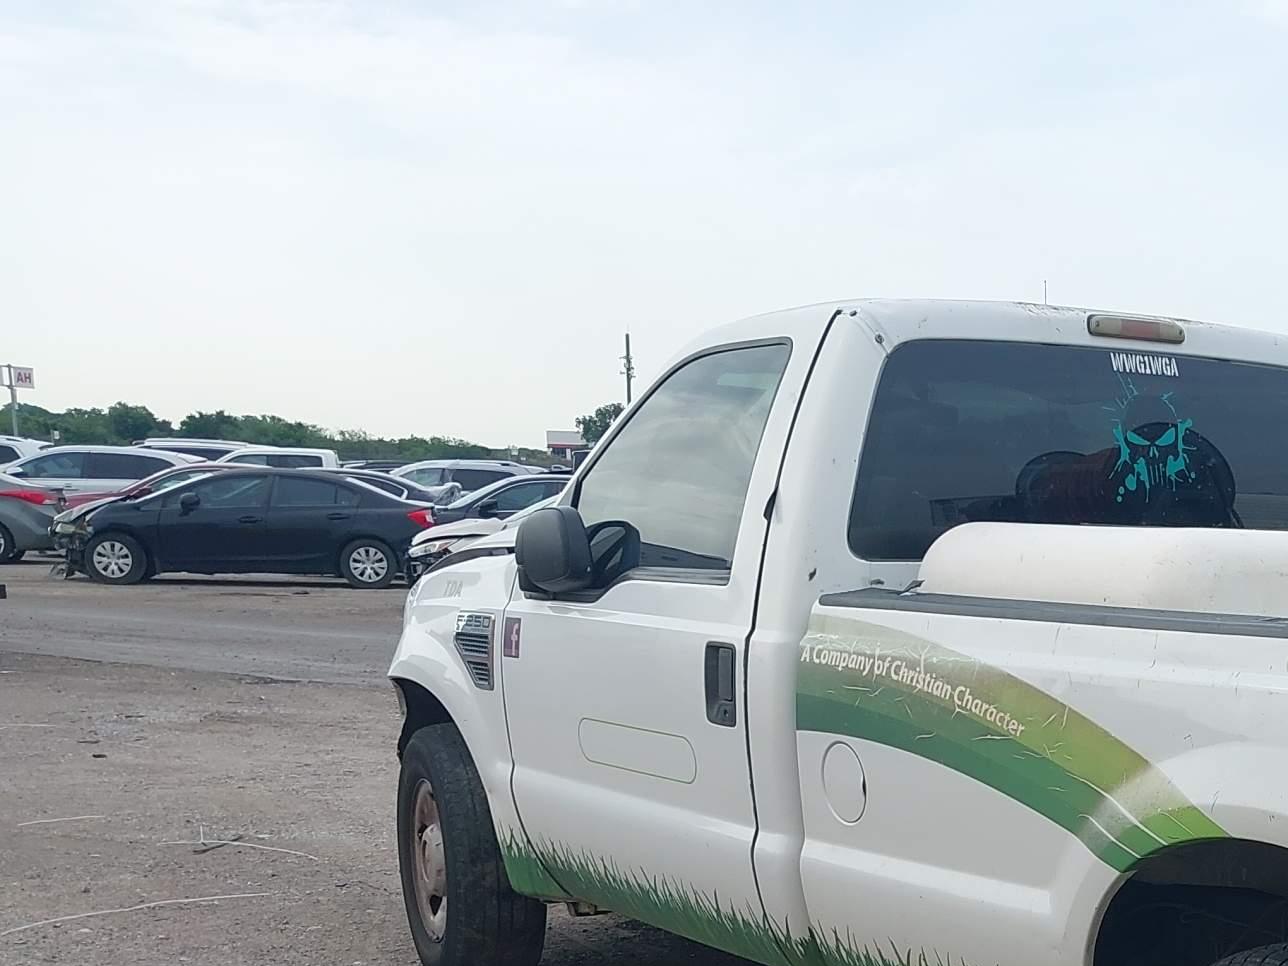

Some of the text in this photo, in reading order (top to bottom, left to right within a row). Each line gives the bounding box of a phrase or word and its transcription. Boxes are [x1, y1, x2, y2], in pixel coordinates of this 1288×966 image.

[1109, 351, 1180, 378] WWG1WGA
[800, 645, 1026, 737] A Company of Christian Character
